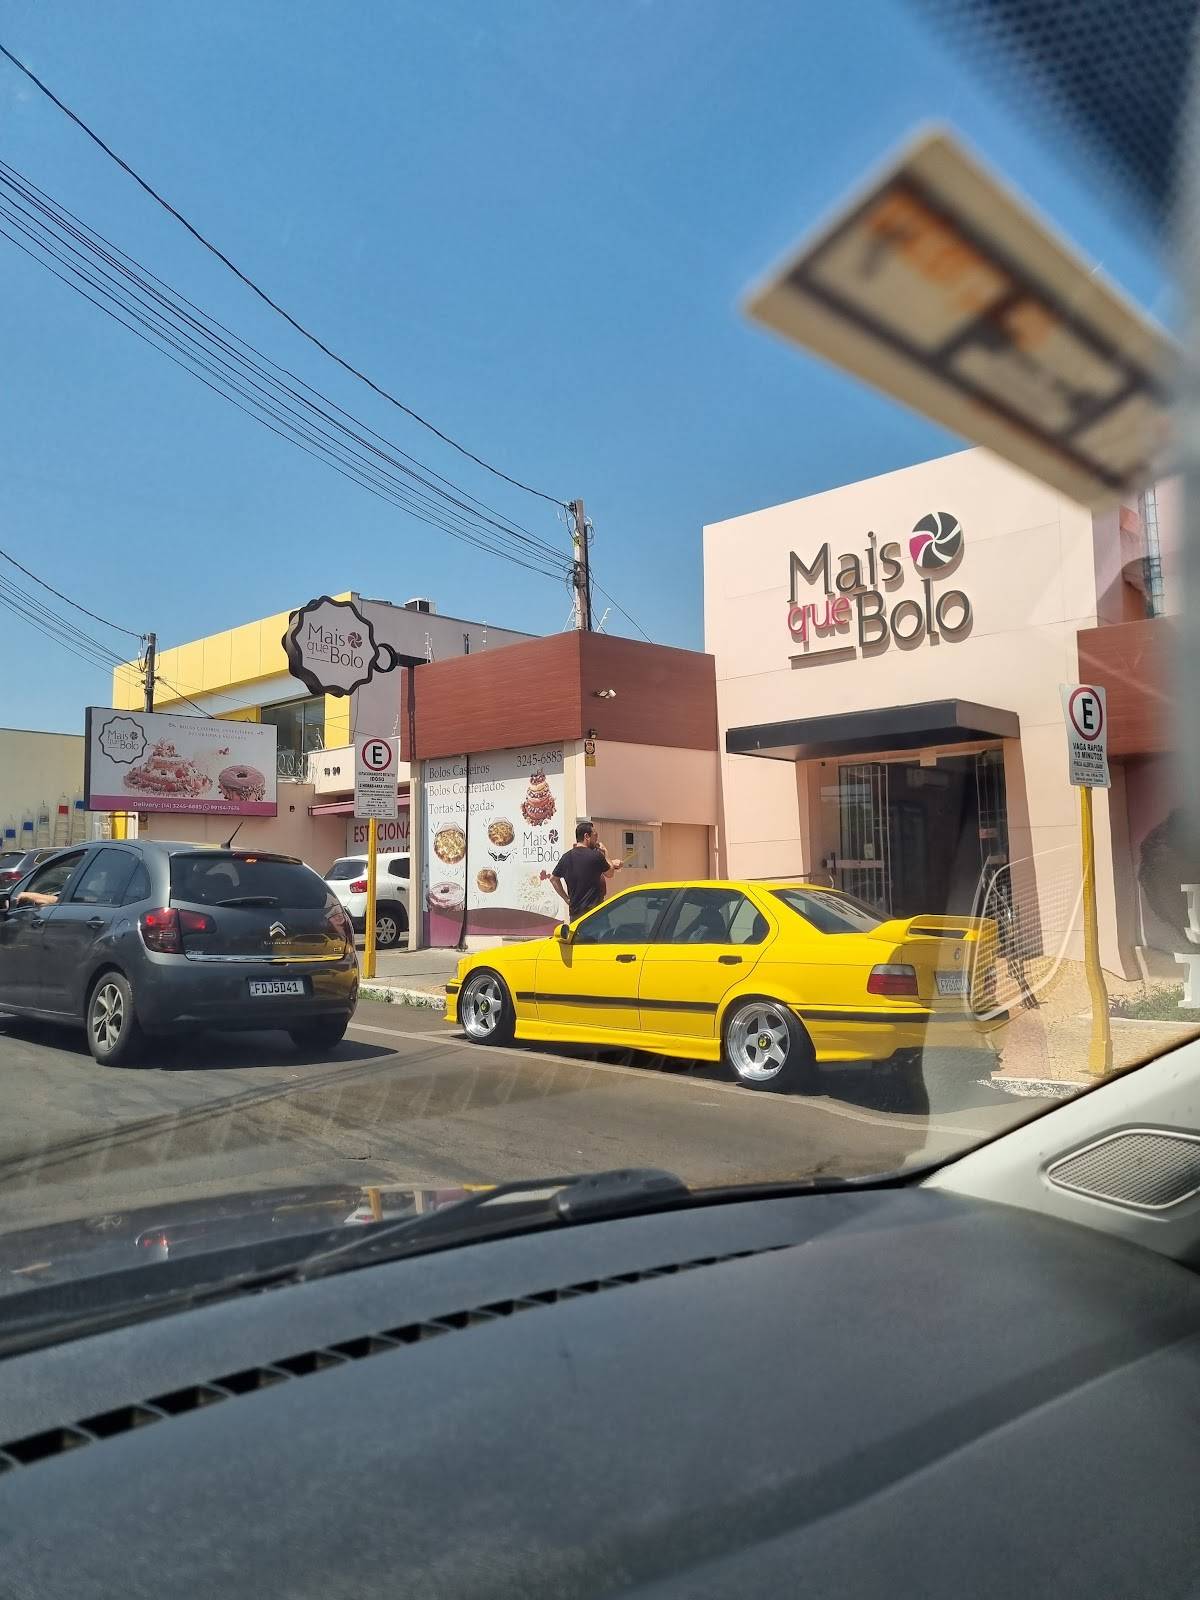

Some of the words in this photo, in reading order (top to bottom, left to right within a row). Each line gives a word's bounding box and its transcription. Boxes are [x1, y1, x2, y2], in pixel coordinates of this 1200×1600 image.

[787, 531, 903, 602] Mais
[787, 597, 851, 642] que
[854, 577, 971, 648] Bolo
[308, 622, 346, 646] Mais
[306, 641, 329, 653] que
[330, 646, 364, 668] Bolo
[1082, 698, 1094, 730] E
[108, 730, 129, 740] Mais
[372, 745, 383, 765] E
[1073, 742, 1087, 751] VAGA
[516, 750, 563, 768] 3245-6885
[1081, 751, 1103, 761] MINUTOS
[429, 766, 451, 779] Bolos
[429, 784, 451, 797] Bolos
[133, 801, 161, 809] Delivery:
[429, 803, 454, 815] Tortas
[455, 799, 495, 816] Sagadas
[353, 821, 411, 843] ESTCIONA
[523, 830, 548, 846] Mais
[537, 845, 561, 863] Bolo
